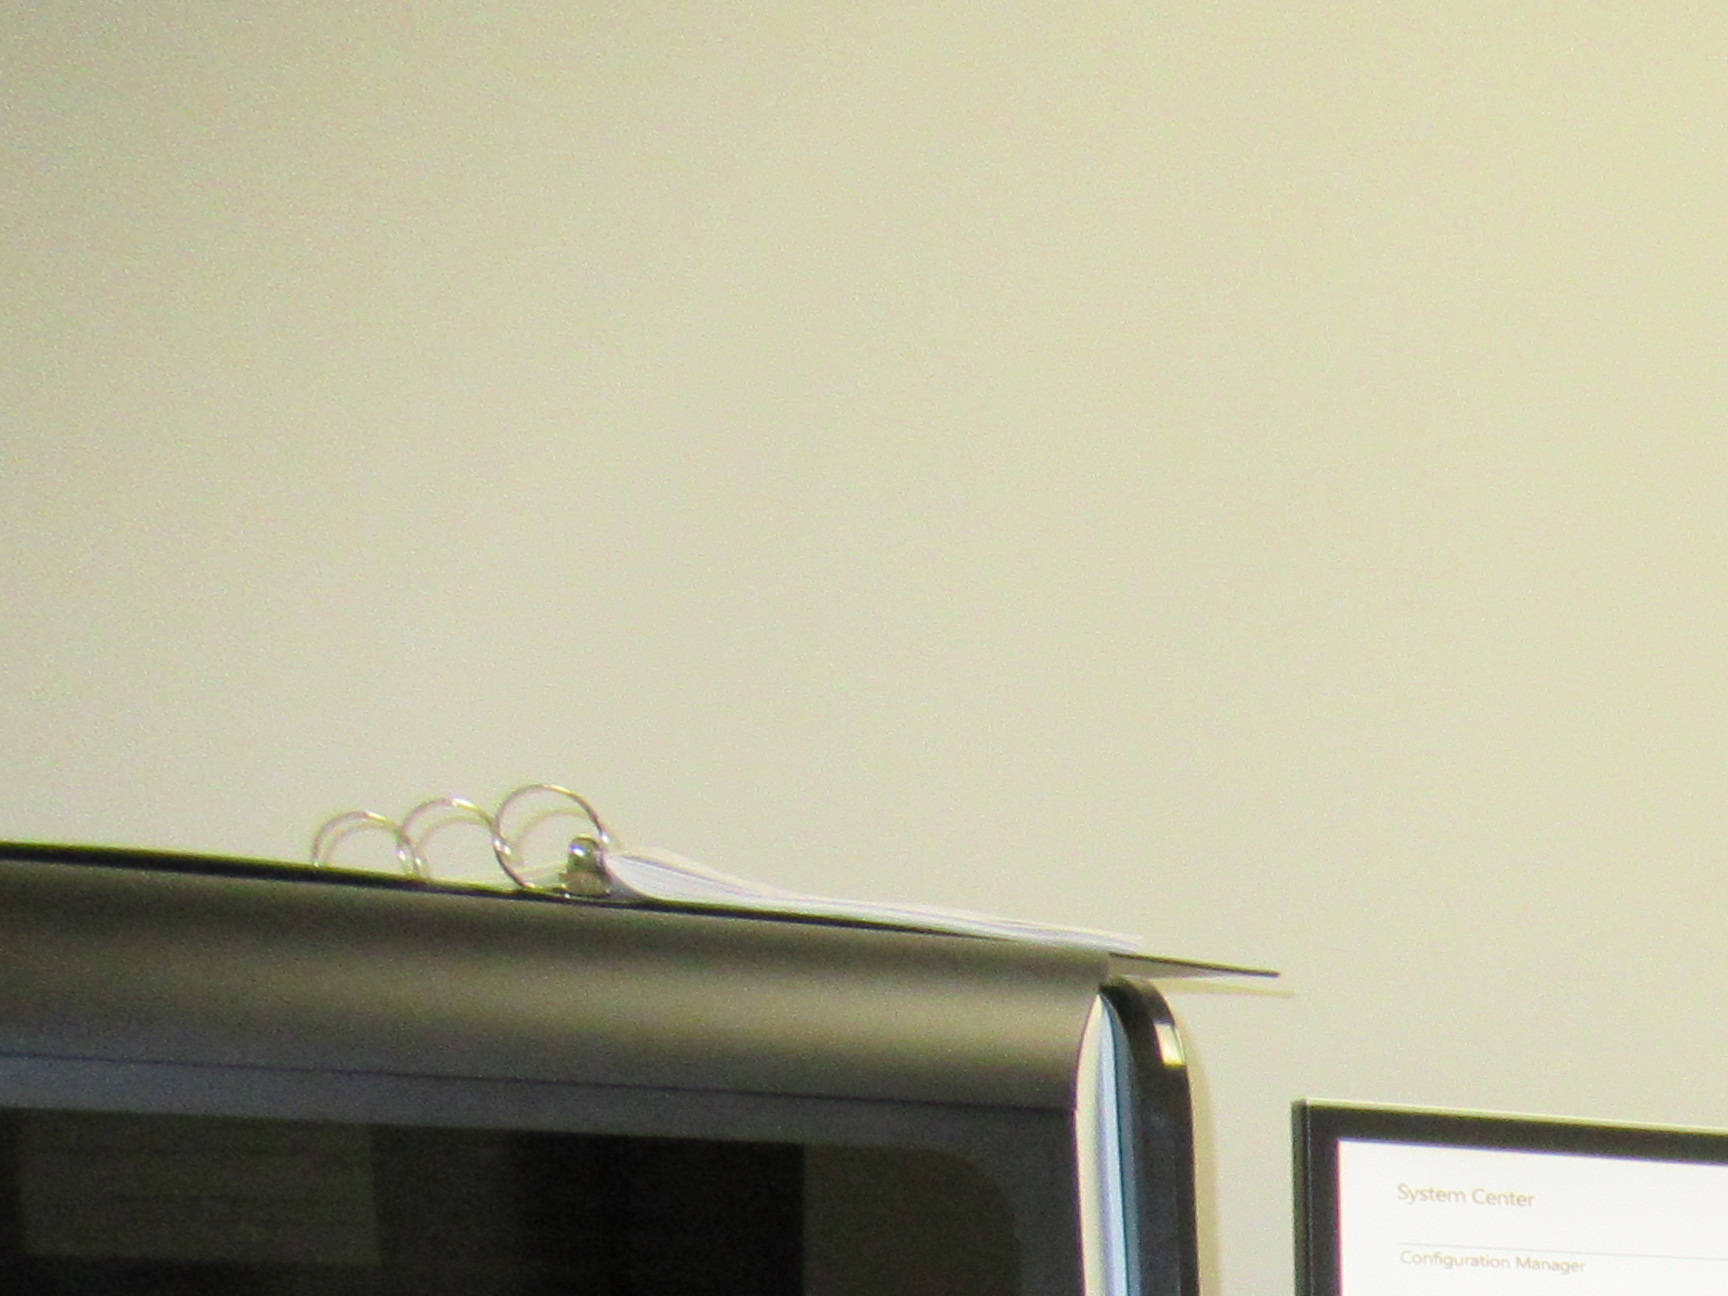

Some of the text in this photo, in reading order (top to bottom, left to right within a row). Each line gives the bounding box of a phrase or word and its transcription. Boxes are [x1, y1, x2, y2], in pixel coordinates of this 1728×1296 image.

[1397, 1183, 1536, 1207] System Center
[1399, 1250, 1586, 1275] Configuration Manager
